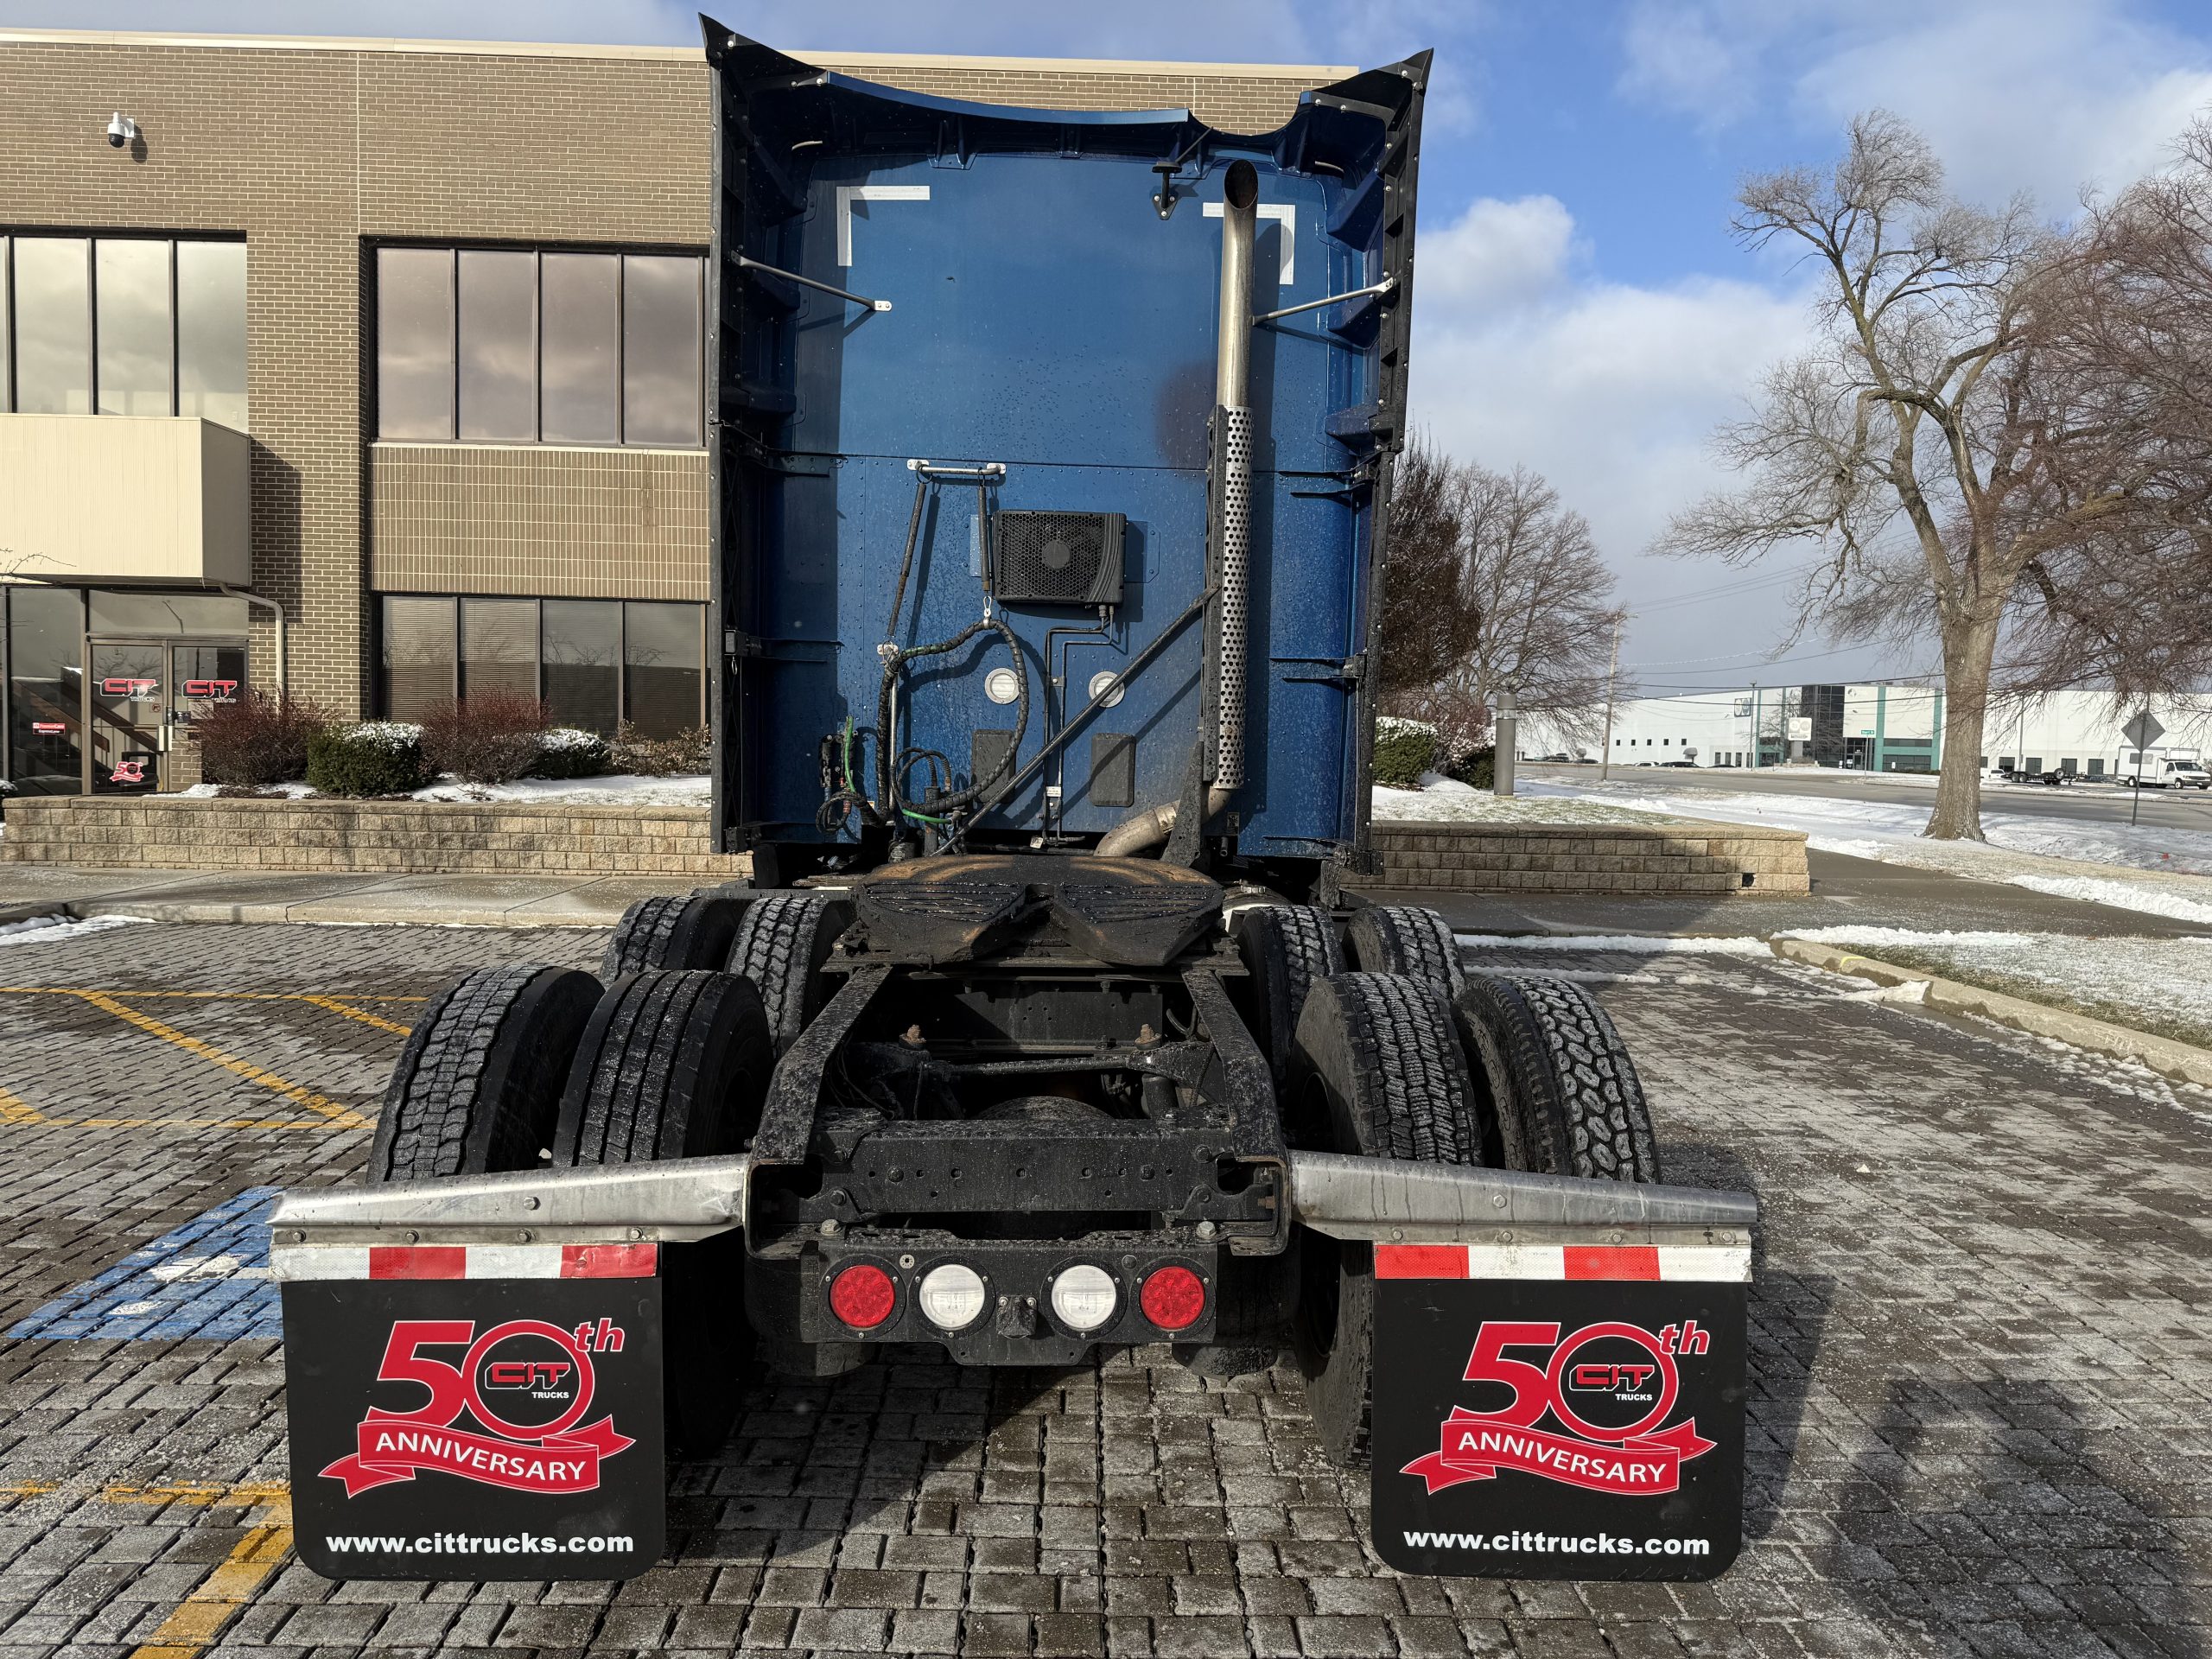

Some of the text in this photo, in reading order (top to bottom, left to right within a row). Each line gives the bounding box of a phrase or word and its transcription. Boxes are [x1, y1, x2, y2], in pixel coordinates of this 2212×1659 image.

[100, 678, 156, 696] CIT
[181, 679, 238, 698] CIT
[485, 1362, 570, 1389] CIT
[1569, 1363, 1655, 1391] CIT
[375, 1432, 587, 1481] ANNIVERSARY
[1458, 1431, 1667, 1483] ANNIVERSARY
[326, 1532, 634, 1554] www.cittrucks.com
[1403, 1530, 1710, 1554] www.cittrucks.com
